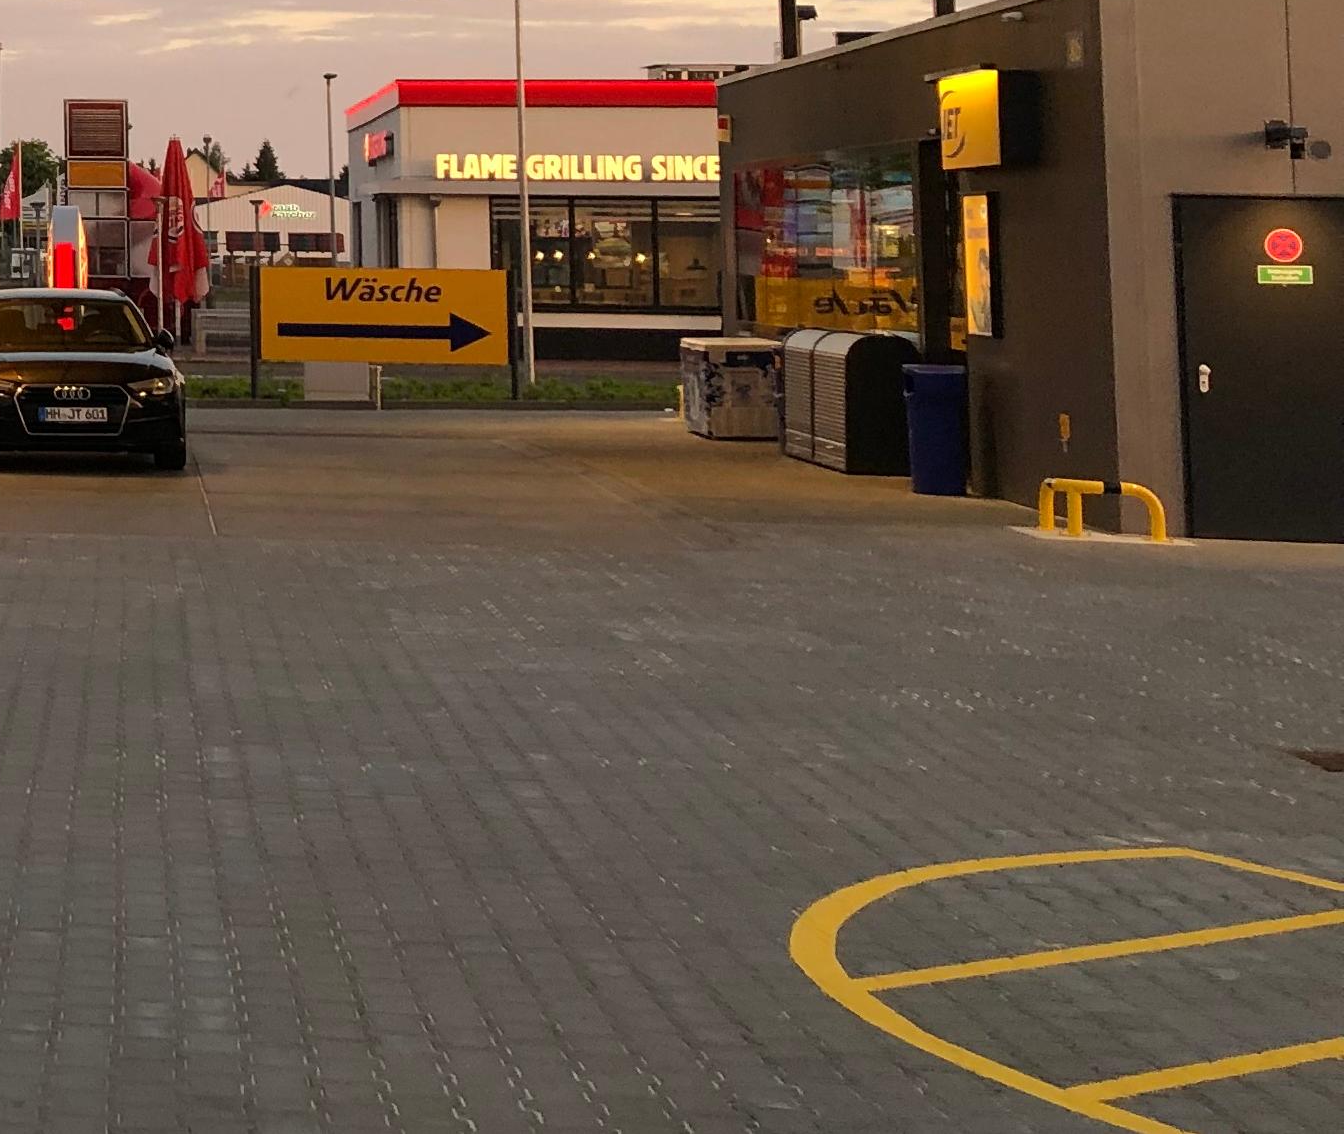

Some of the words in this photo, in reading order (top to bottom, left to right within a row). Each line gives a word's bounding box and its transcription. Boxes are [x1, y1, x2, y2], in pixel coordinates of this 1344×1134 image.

[435, 153, 518, 180] FLAME
[525, 154, 643, 181] GRILLING
[650, 154, 720, 181] SINCE
[325, 276, 442, 303] Wäsche
